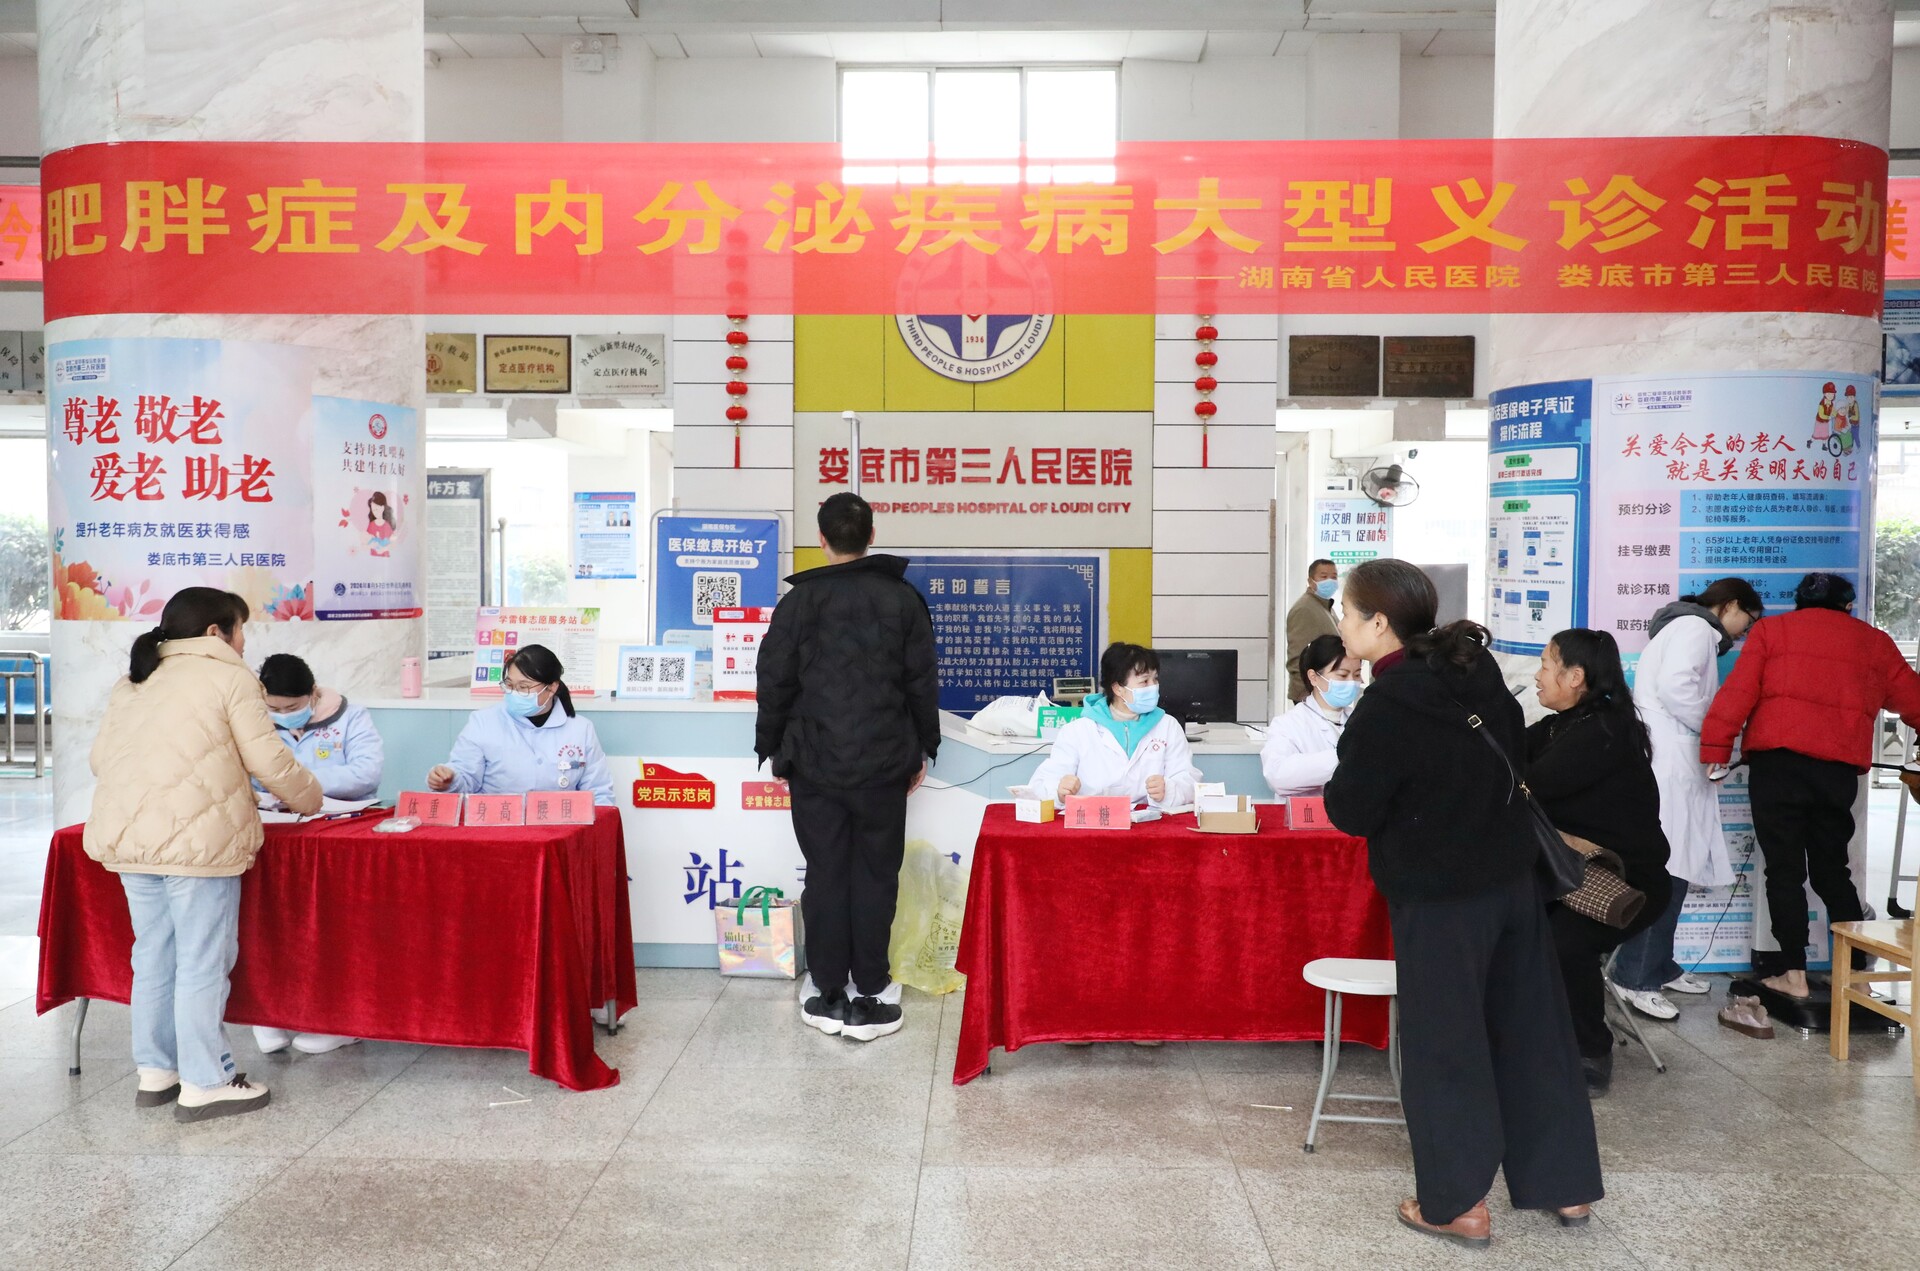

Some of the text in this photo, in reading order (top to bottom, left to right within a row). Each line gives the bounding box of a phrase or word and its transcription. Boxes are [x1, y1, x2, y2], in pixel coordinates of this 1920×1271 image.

[46, 173, 1880, 262] 肥胖症及内分泌疾病大型义诊活动
[1557, 263, 1879, 294] 娄底市第三人民医院
[906, 318, 923, 347] THIRD
[964, 358, 1014, 376] HOSPITAL
[1014, 348, 1026, 360] OF
[499, 363, 555, 373] 定点医疗机构
[594, 368, 647, 377] 定点医疗机构
[63, 395, 225, 445] 尊老 敬老
[1500, 421, 1543, 442] 操作流程
[1622, 432, 1796, 458] 关爱今天的老人
[819, 446, 1133, 486] 娄底市第三人民医院
[1666, 457, 1858, 481] 就是关爱明天的自己
[90, 452, 275, 503] 爱老 助老
[892, 502, 954, 514] PEOPLES
[957, 502, 1027, 514] HOSPITAL
[1030, 502, 1048, 514] OF
[1051, 502, 1094, 514] LOUDI
[1097, 502, 1131, 514] CITY
[1618, 503, 1671, 515] 预约分诊
[1321, 512, 1386, 525] 讲文明 树新风
[75, 521, 250, 539] 提升老年病友就医获得感
[668, 538, 768, 554] 医保缴费开始了
[1618, 545, 1671, 557] 挂号缴费
[147, 552, 286, 567] 娄底市第三人民医院
[930, 579, 1010, 594] 我的誓言
[1617, 583, 1671, 595] 就诊环境
[499, 615, 578, 625] 学雷锋志愿服务站
[637, 787, 711, 803] 党员示范岗
[408, 798, 440, 819] 体重
[476, 800, 511, 821] 身高
[537, 799, 573, 820] 腰围
[1075, 805, 1111, 827] 血糖
